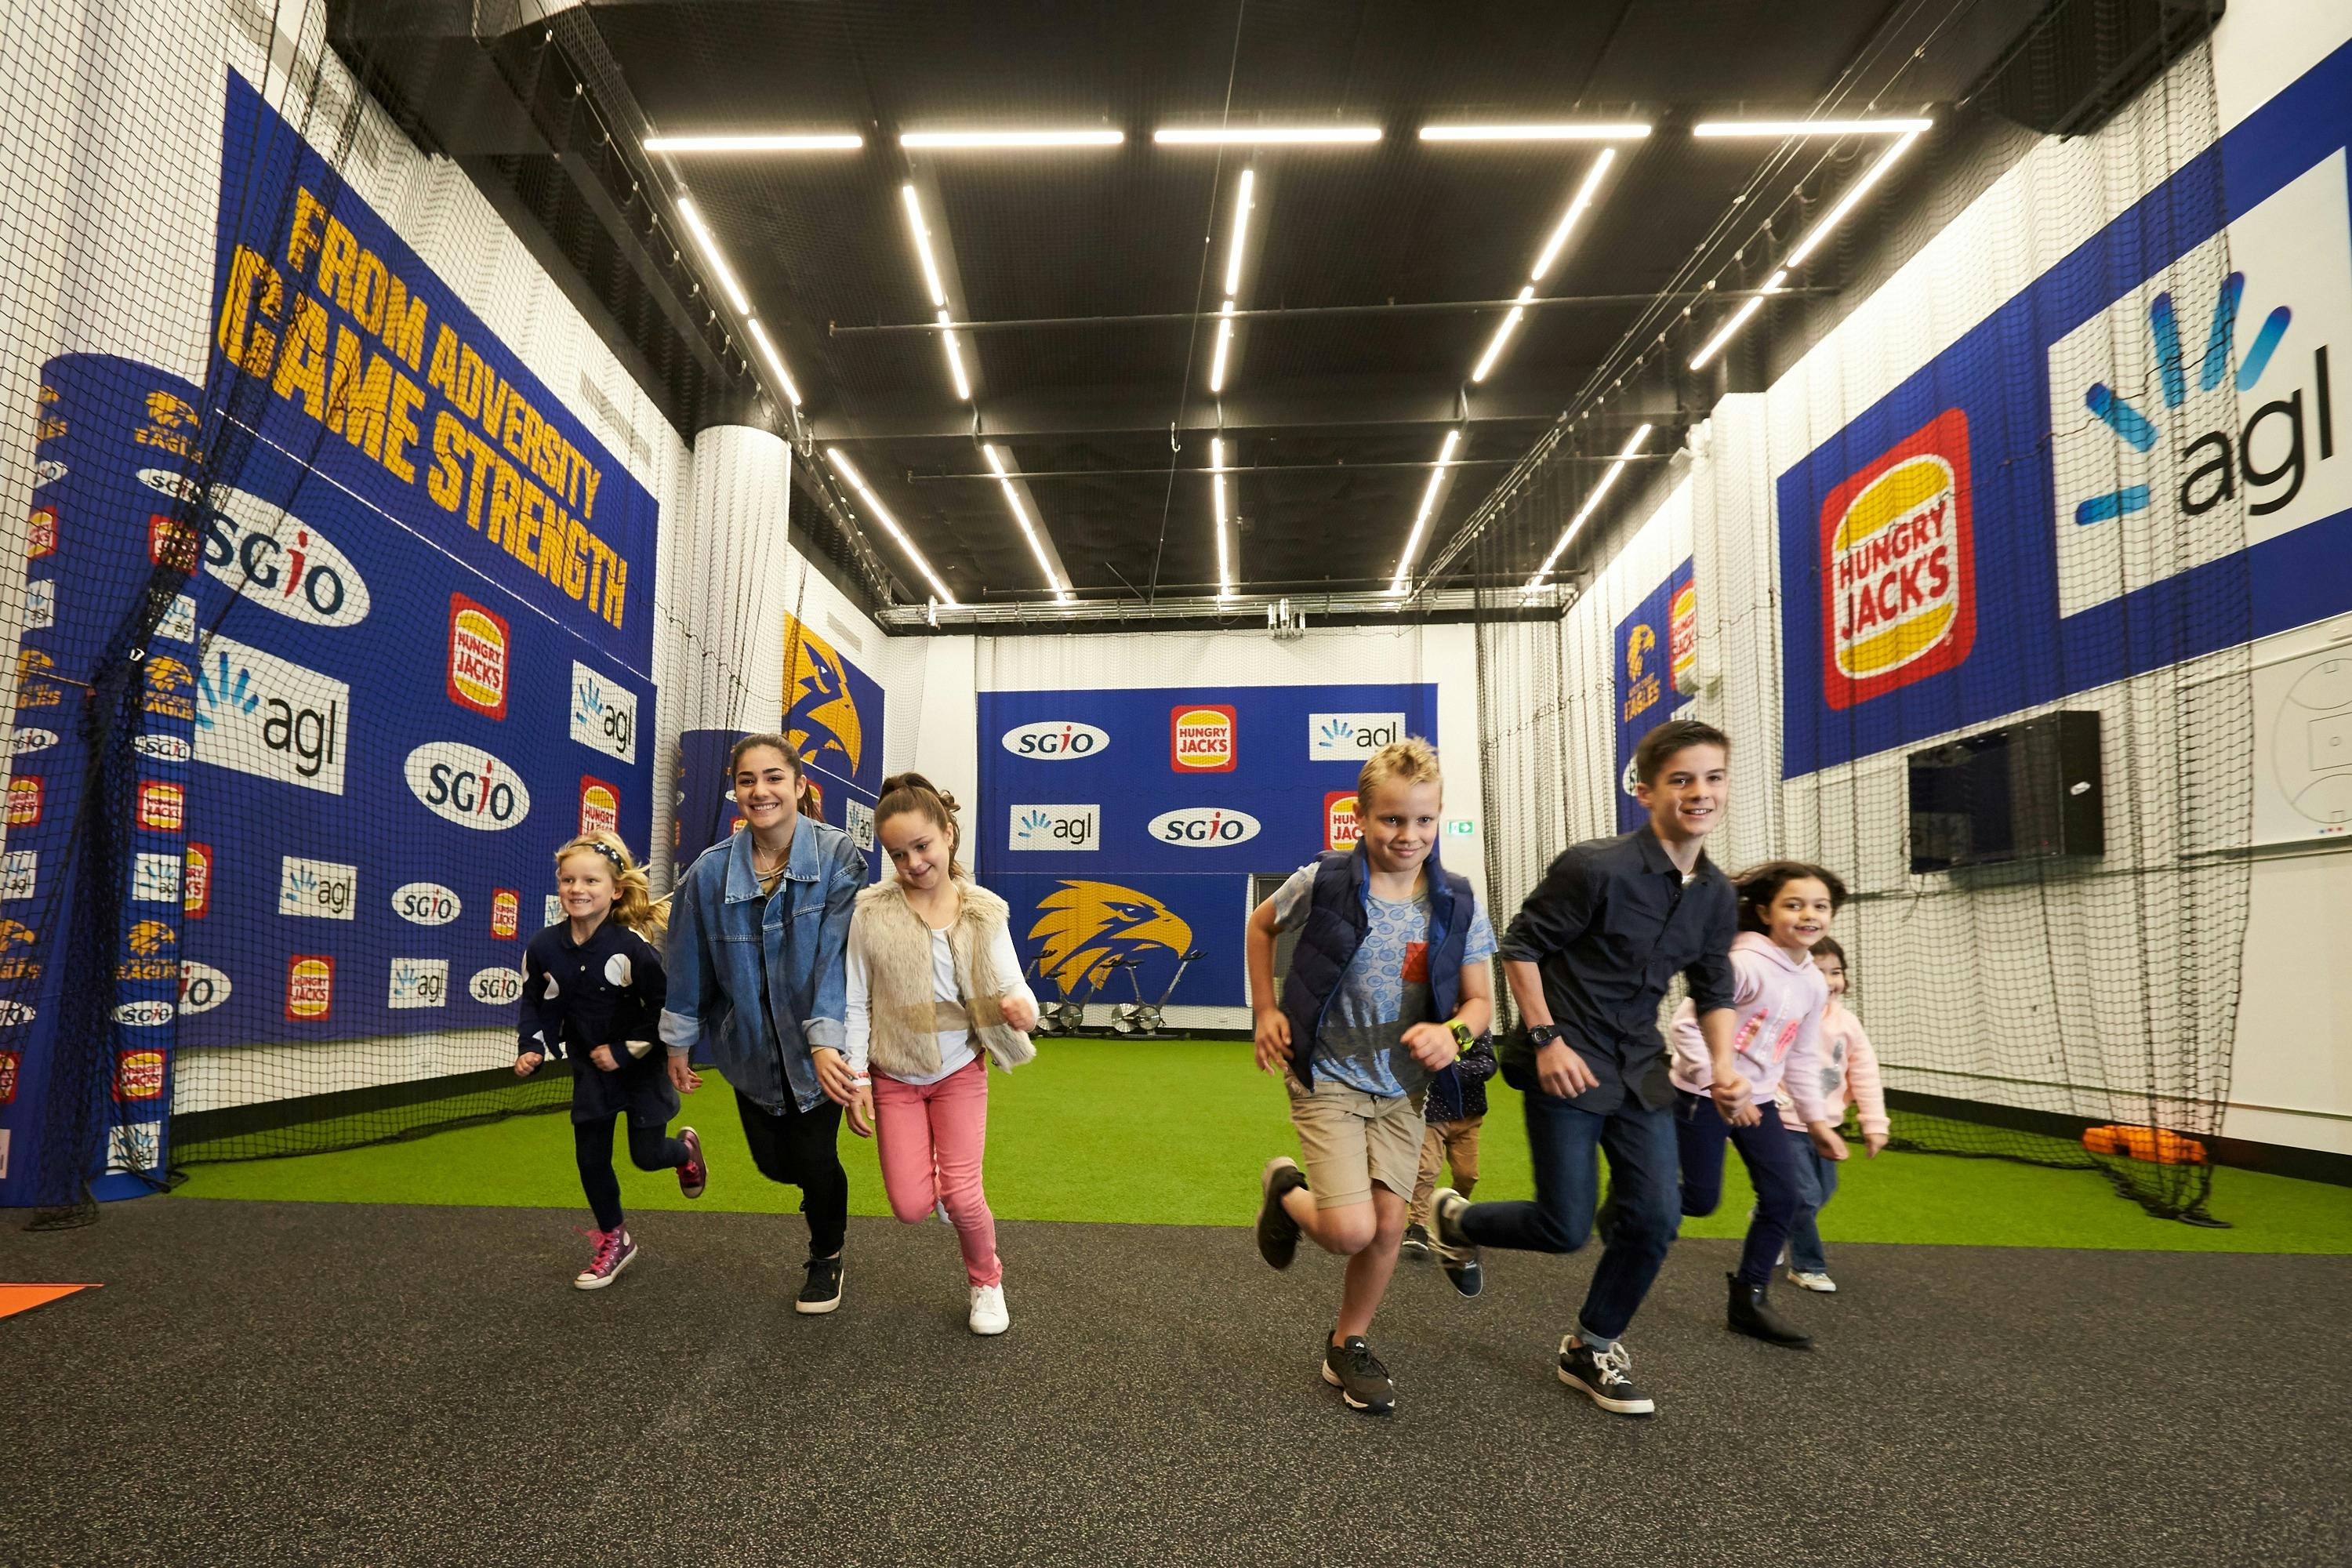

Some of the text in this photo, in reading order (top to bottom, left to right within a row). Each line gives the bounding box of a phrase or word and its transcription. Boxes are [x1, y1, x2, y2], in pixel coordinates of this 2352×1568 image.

[287, 185, 601, 519] FROM ADVERSITY
[218, 244, 627, 629] GAME STRENGTH
[2180, 343, 2333, 517] agl
[1839, 501, 1946, 590] HUNGRY
[458, 632, 501, 664] HUNGRY
[263, 698, 336, 777] agl
[604, 702, 633, 753] agl
[1179, 728, 1228, 738] HUNGRY
[1054, 813, 1091, 845] agl
[1334, 815, 1356, 825] HUN
[1334, 826, 1361, 840] JAC
[318, 876, 351, 914] agl
[293, 977, 326, 986] HUNGRY
[417, 969, 443, 1003] agl
